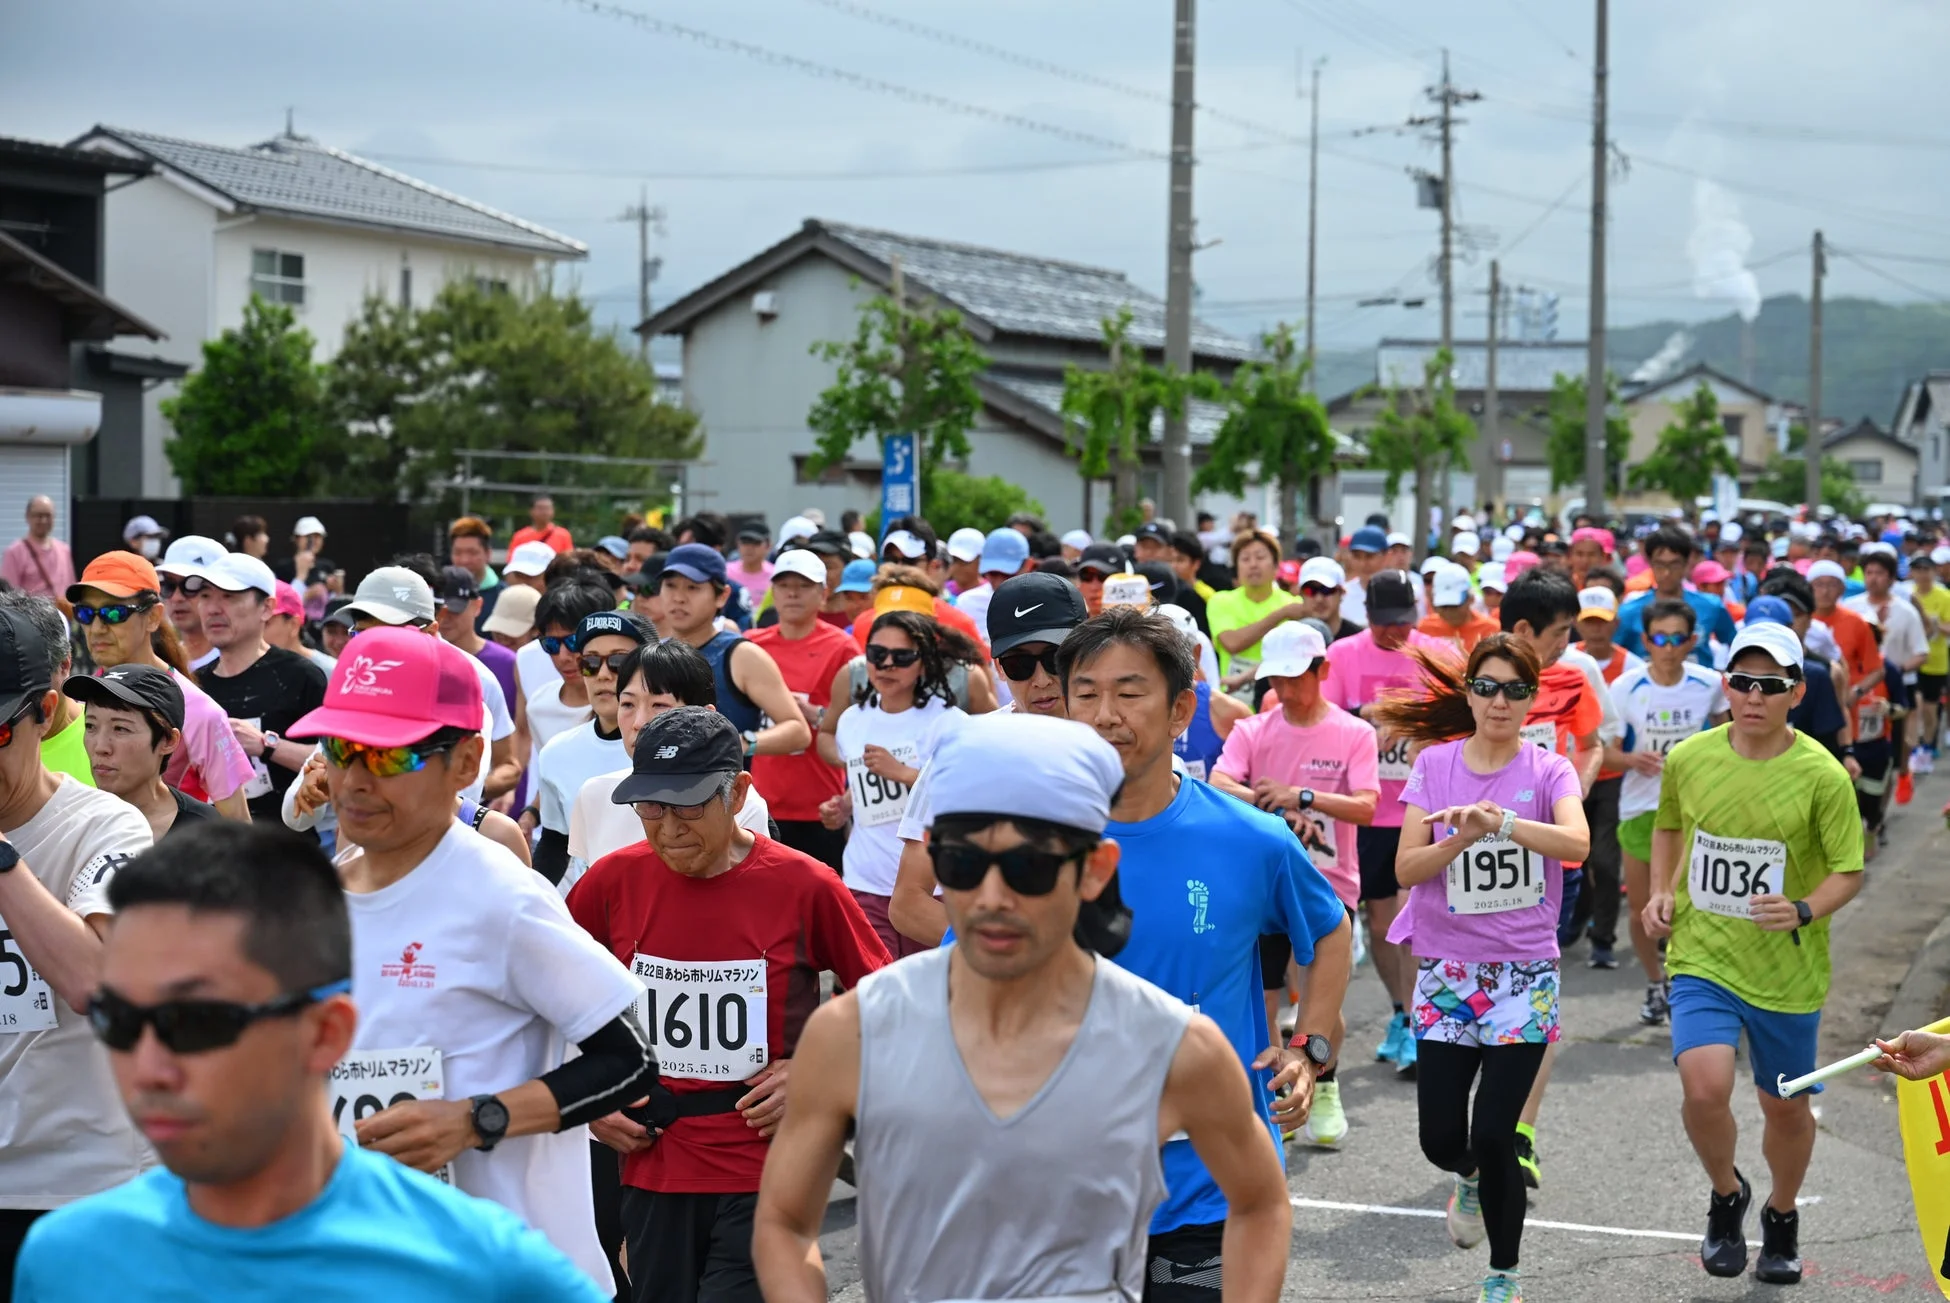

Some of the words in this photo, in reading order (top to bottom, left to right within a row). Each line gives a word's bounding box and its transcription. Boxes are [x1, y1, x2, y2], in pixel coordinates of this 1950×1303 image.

[1463, 847, 1531, 893] 1951
[1701, 854, 1771, 898] 1036
[1474, 897, 1522, 909] 2025.5.18
[635, 961, 759, 983] 第22回あわら市トリムマラソン
[647, 988, 748, 1051] 1610
[661, 1060, 730, 1074] 2025.5.18
